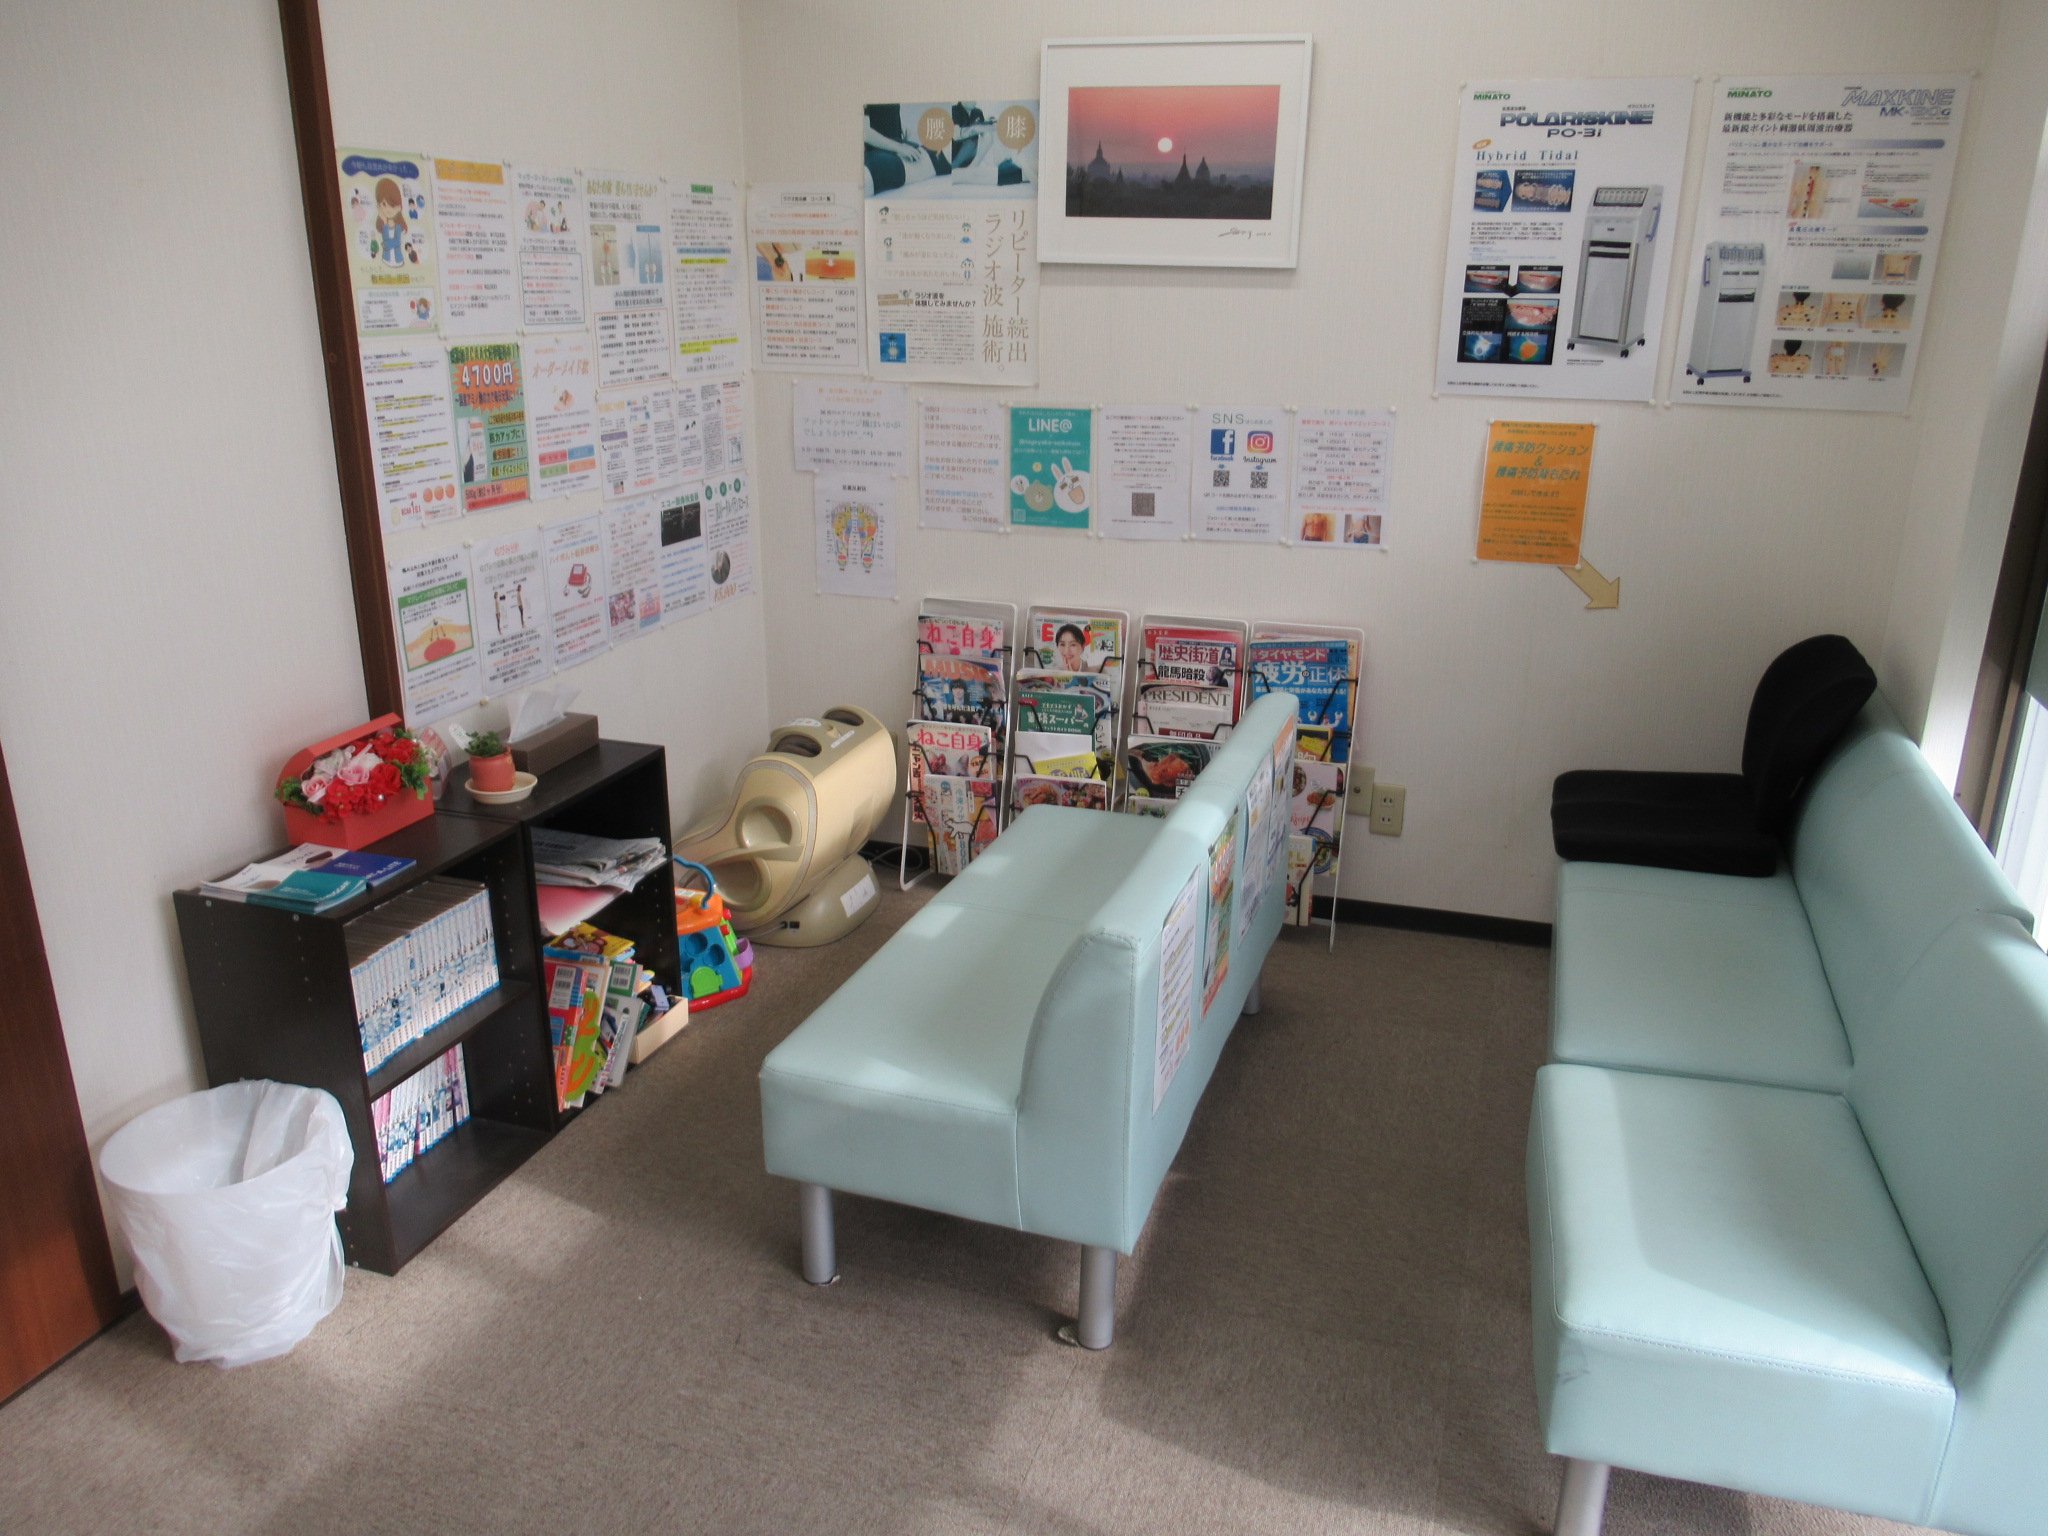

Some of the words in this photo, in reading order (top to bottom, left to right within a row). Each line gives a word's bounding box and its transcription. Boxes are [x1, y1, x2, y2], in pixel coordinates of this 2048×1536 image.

[1727, 90, 1773, 98] MINATO
[1841, 88, 1956, 107] MAXKINE
[1500, 110, 1654, 127] POLARISKINE
[1723, 111, 1853, 121] 新機能と多彩なモードを搭載した
[925, 117, 946, 140] 腰
[1005, 116, 1026, 139] 膝
[1547, 128, 1602, 138] PO-3i
[1476, 150, 1527, 164] Hybrid
[1539, 150, 1578, 161] Tidal
[1007, 209, 1029, 364] リピーター続出
[462, 362, 514, 388] 4700円
[1028, 418, 1072, 433] LINE@
[1212, 413, 1244, 425] SNS
[1492, 441, 1590, 456] 腰痛予防クッション
[1243, 456, 1277, 466] Instagram
[926, 623, 995, 649] ねこ自身
[1158, 644, 1220, 665] 歴史街道
[1258, 648, 1326, 660] ダイヤモンド
[1158, 665, 1206, 682] 龍馬暗殺
[1143, 689, 1230, 707] PRESIDENT
[918, 728, 982, 751] ねこ自身
